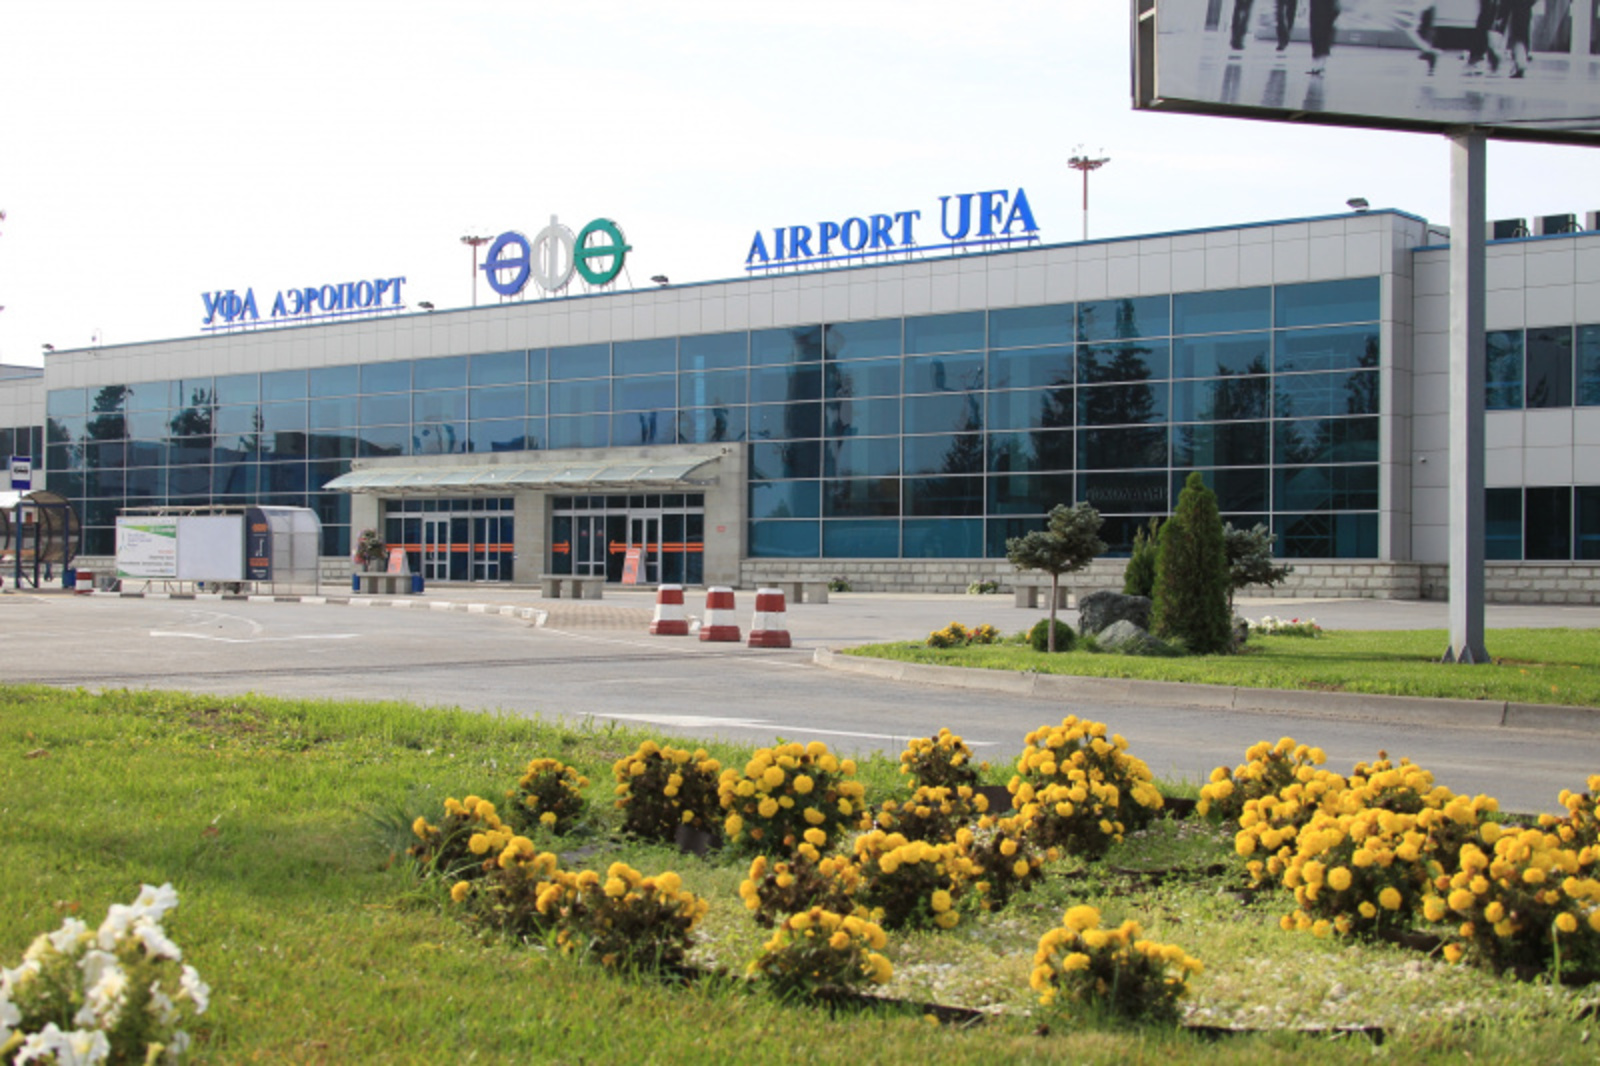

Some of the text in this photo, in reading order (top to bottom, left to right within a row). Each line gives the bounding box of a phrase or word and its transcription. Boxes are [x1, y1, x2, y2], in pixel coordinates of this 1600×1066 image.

[745, 187, 1040, 264] AIRPORT UFA
[201, 276, 406, 324] УФА АЭРОПОРТ
